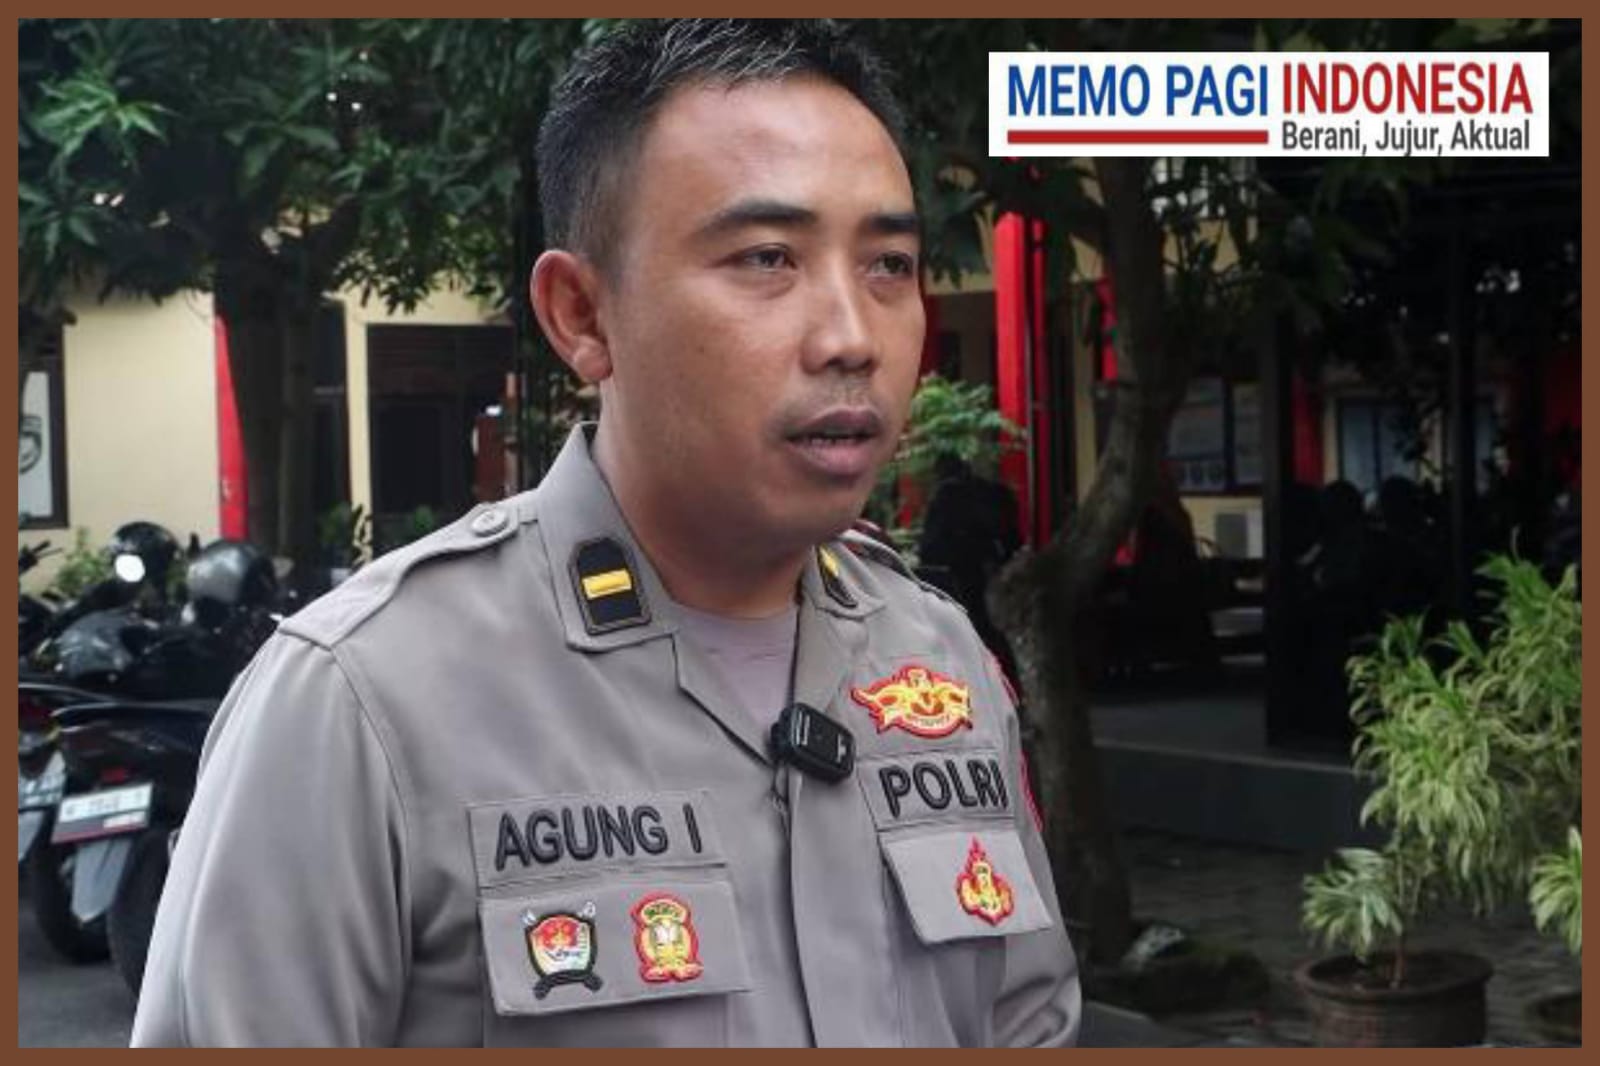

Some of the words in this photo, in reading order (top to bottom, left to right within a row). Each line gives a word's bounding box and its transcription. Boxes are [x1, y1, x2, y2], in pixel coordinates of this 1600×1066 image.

[878, 758, 1010, 818] POLRI
[495, 805, 669, 871] AGUNG
[682, 803, 702, 853] I
